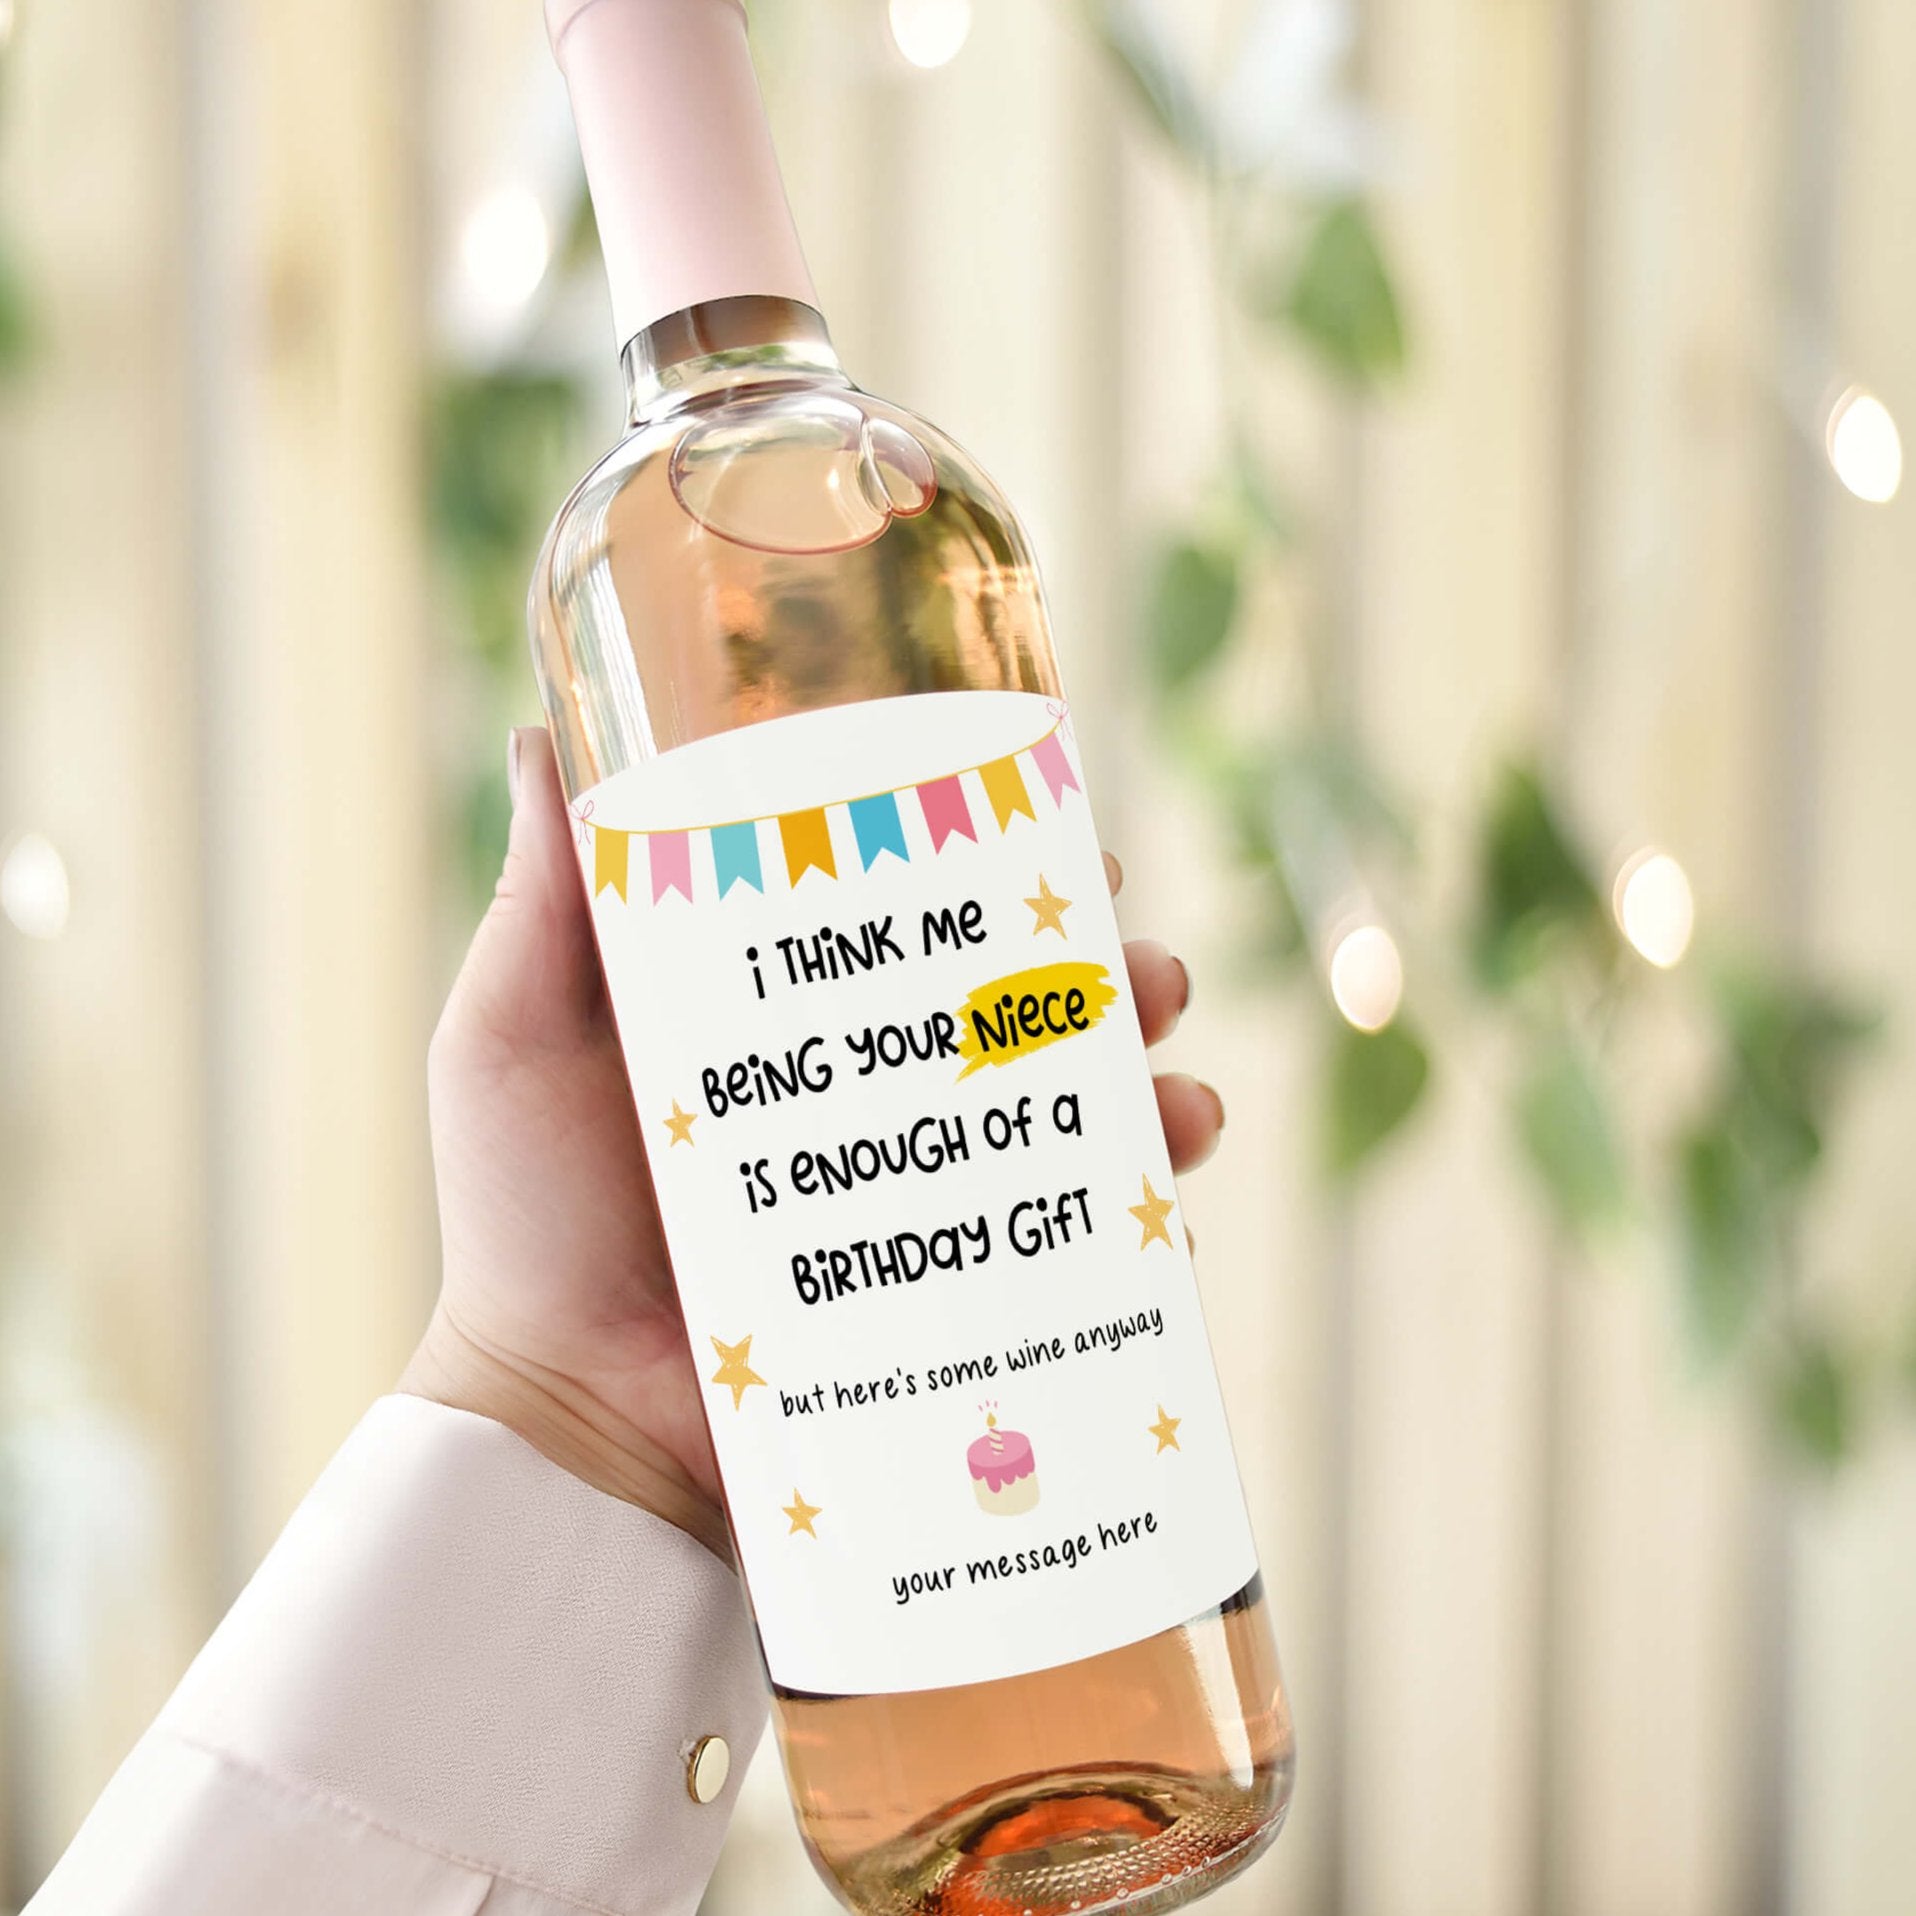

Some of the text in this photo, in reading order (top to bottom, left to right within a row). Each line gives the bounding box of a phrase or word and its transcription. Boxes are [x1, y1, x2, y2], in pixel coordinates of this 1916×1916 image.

[779, 1305, 1165, 1418] but here's some wine anyway
[891, 1510, 1159, 1606] your message here
